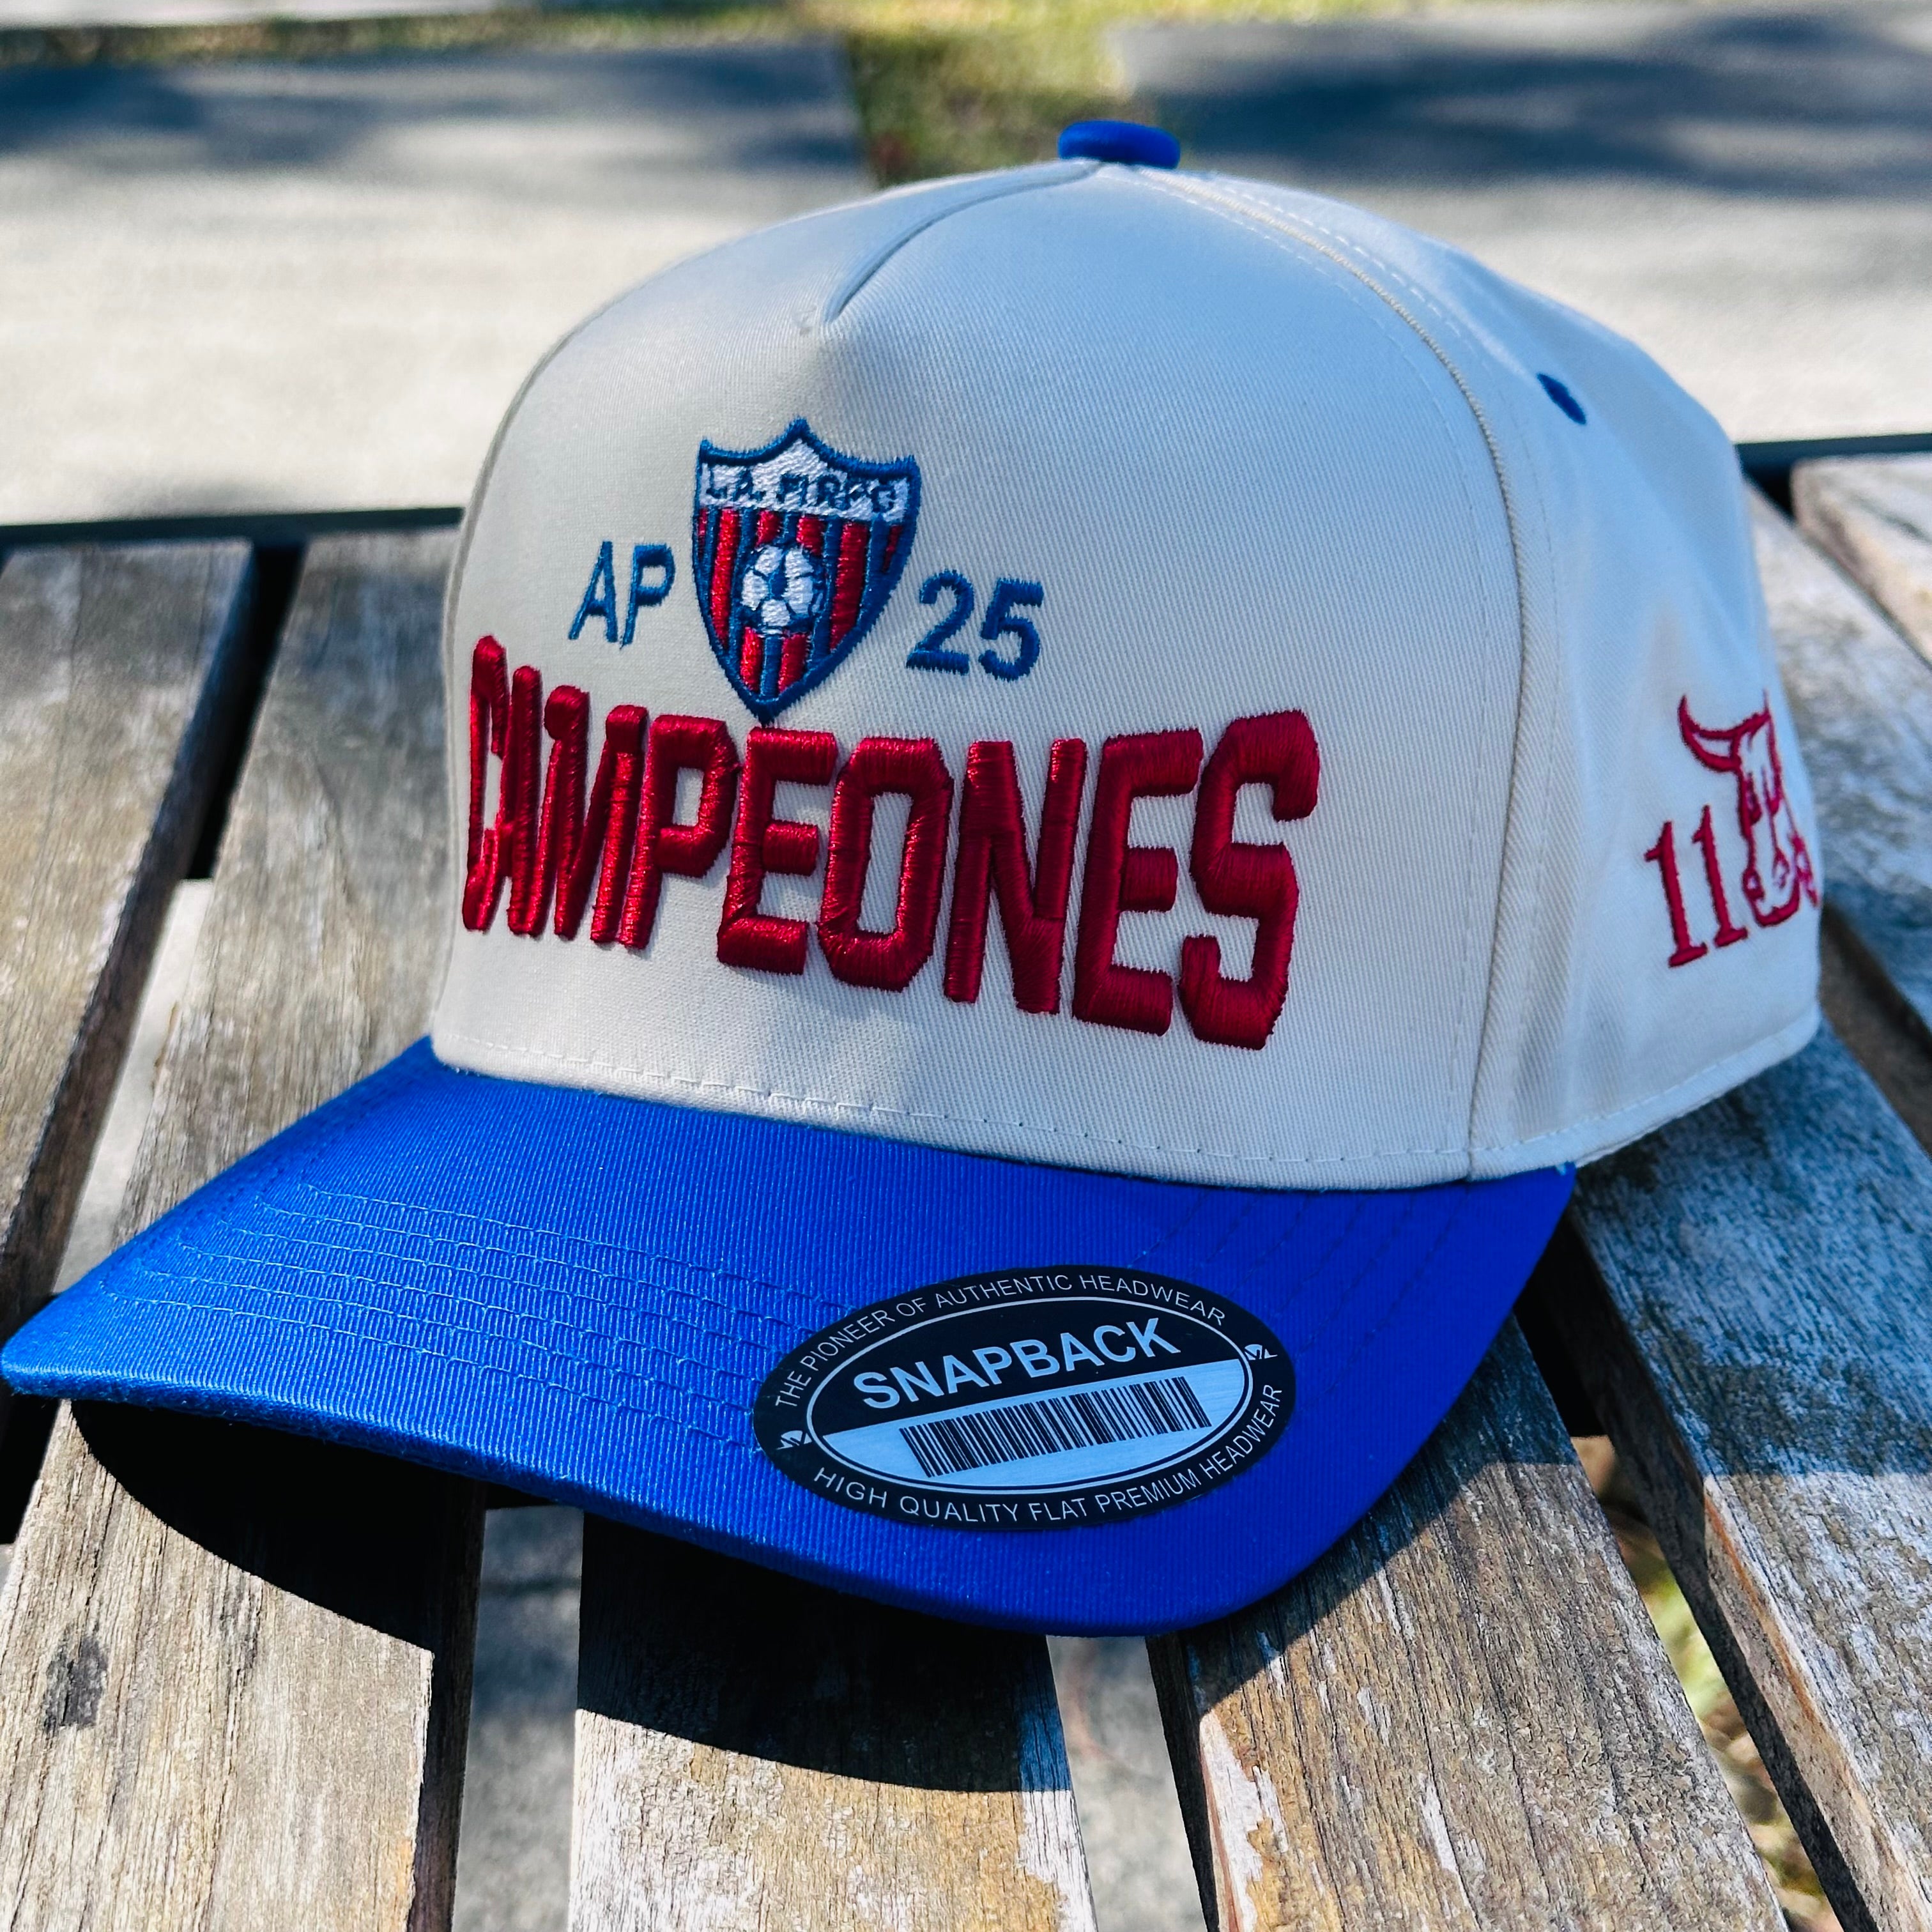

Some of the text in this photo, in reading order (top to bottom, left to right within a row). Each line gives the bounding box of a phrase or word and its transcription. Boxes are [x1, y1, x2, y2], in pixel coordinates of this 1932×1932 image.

[568, 541, 1044, 681] AP 25
[462, 635, 1320, 1051] CAMPEONES
[1644, 804, 1748, 968] 11
[775, 1275, 1225, 1406] THE PIONEER OF AUTHENTIC HEADWEAR
[853, 1317, 1181, 1408] SNAPBACK
[814, 1384, 1283, 1522] HIGH QUALITY FLAT PREMIUM HEADWEAR
